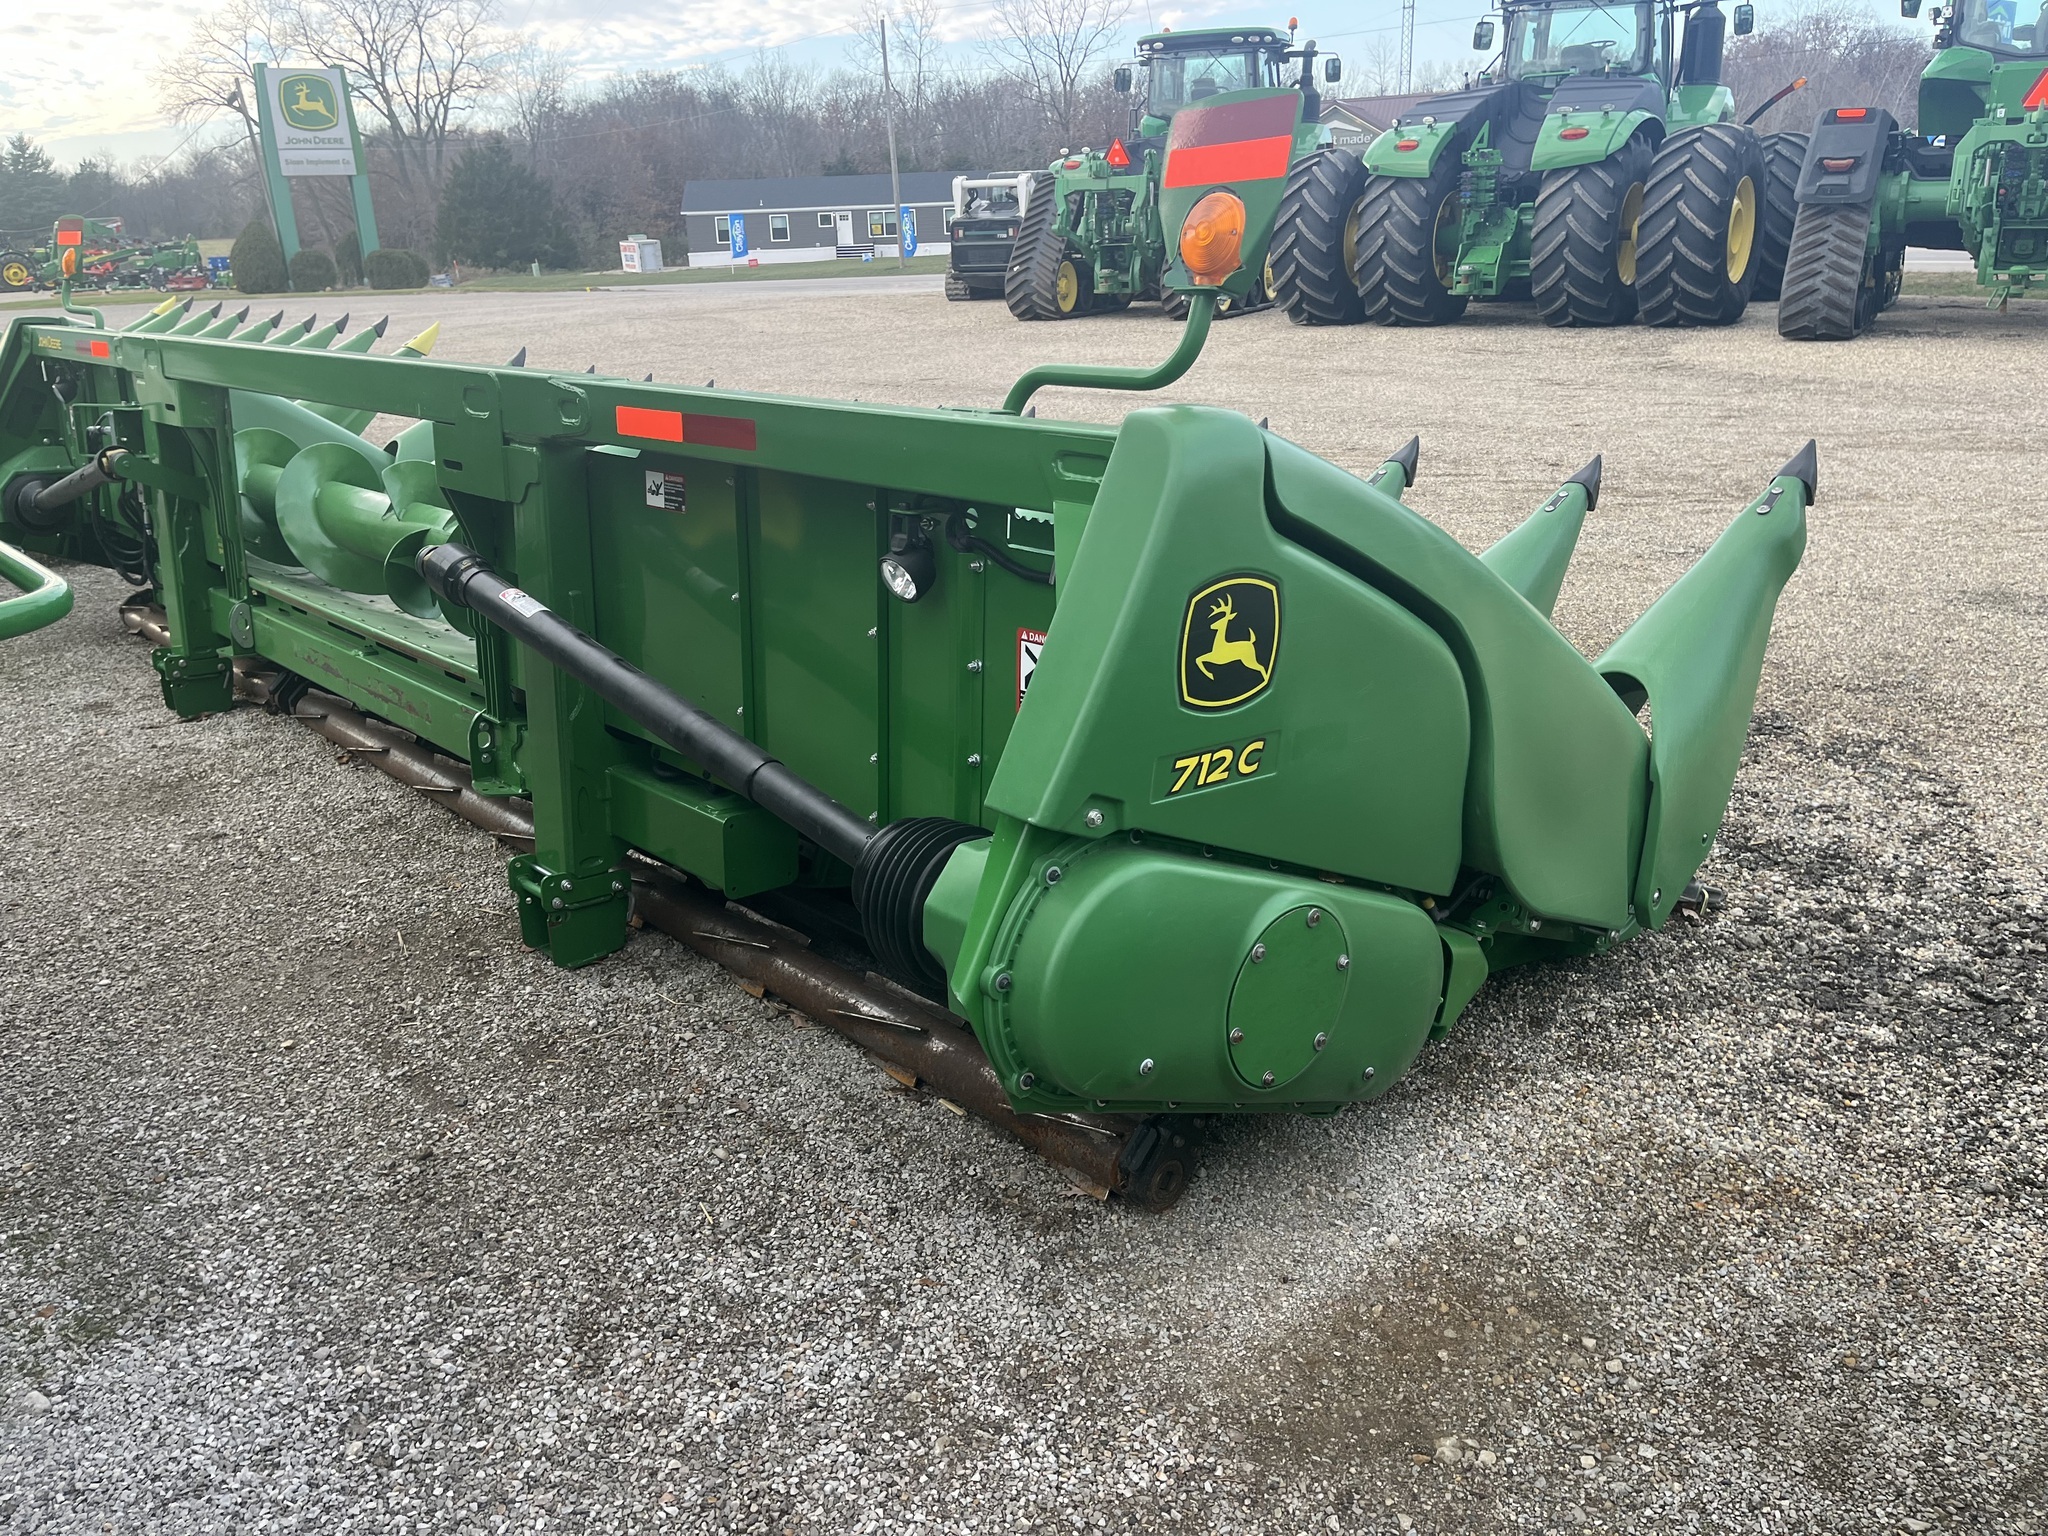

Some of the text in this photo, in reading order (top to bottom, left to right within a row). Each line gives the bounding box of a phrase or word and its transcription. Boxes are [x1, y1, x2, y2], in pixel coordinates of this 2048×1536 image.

[285, 136, 344, 145] JOHN DEERE
[1340, 134, 1370, 144] made
[735, 219, 744, 252] Clayton
[904, 213, 913, 250] Clayton
